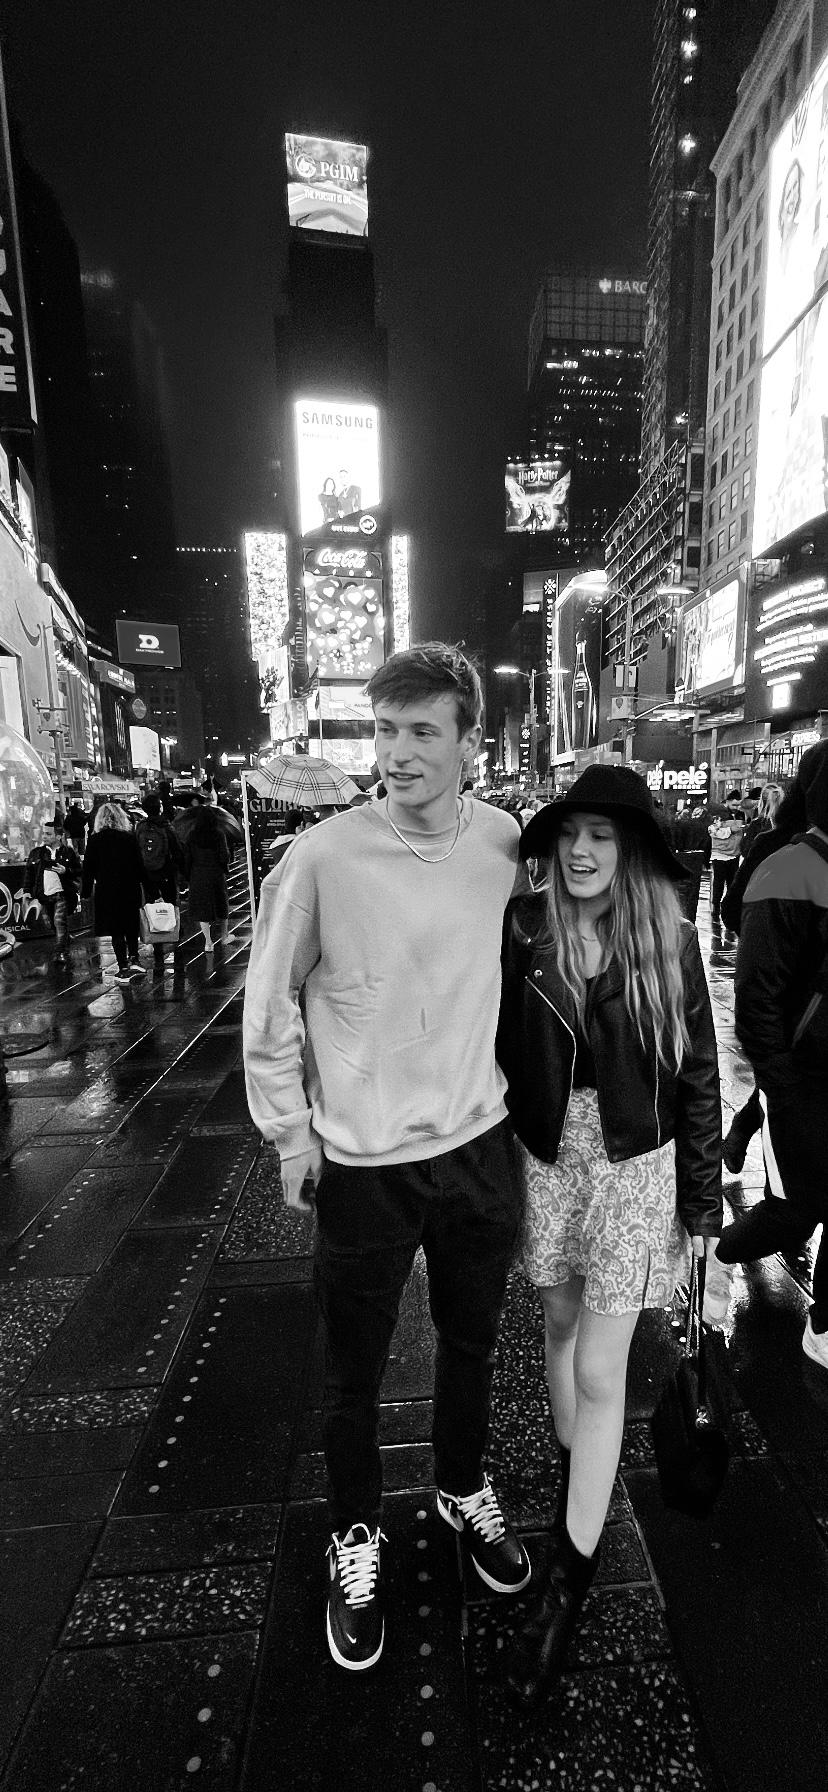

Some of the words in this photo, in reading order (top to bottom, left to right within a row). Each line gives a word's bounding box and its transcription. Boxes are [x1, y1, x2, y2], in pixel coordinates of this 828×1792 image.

[320, 161, 358, 182] PGIM
[304, 188, 315, 199] THE
[302, 411, 373, 429] SAMSUNG
[518, 470, 537, 486] Harry
[537, 467, 559, 482] Potter
